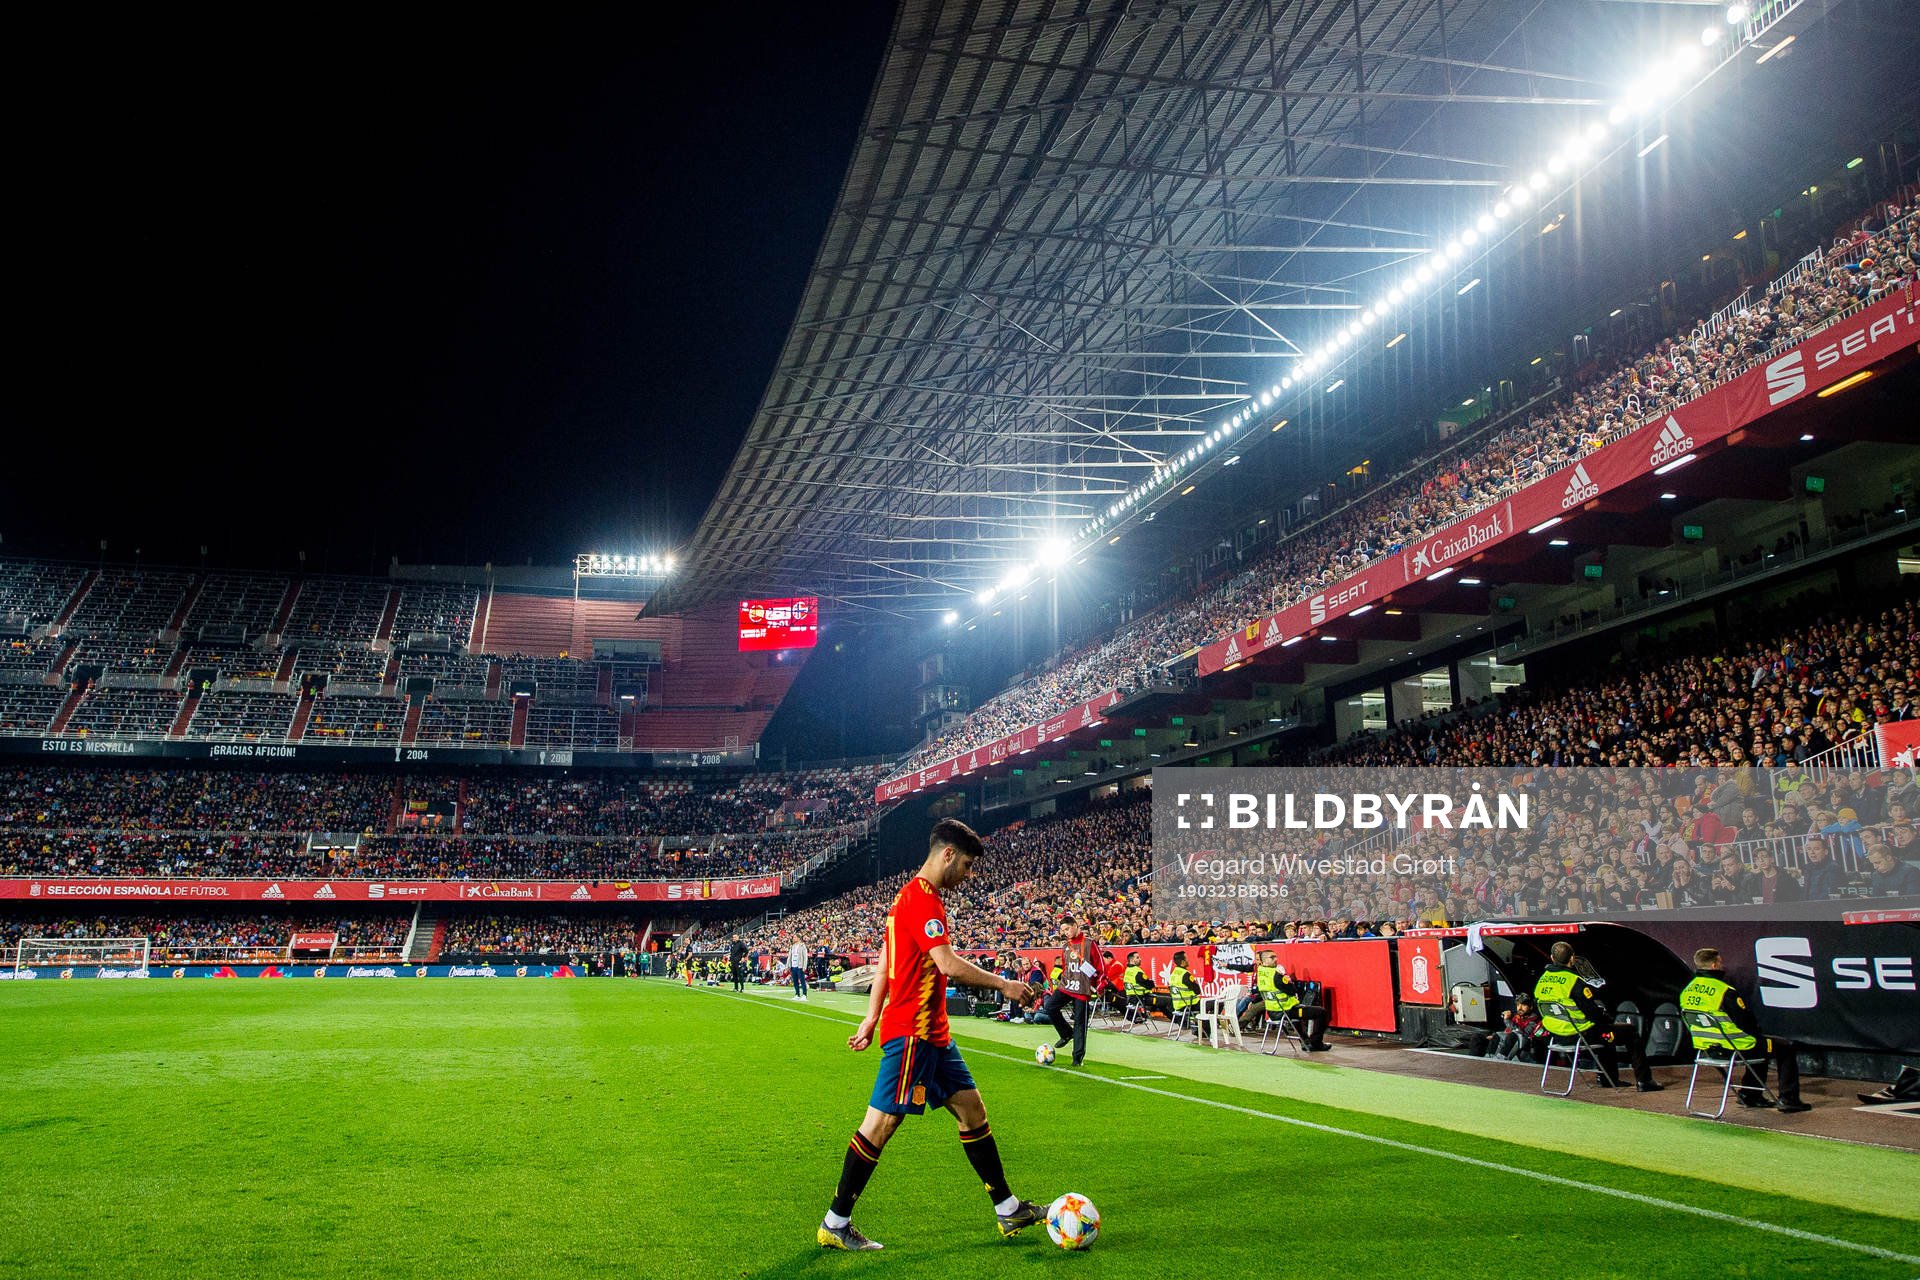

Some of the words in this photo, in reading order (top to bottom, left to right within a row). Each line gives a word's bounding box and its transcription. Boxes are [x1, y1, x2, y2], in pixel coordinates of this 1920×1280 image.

[1815, 299, 1920, 371] SEAT
[1650, 436, 1694, 466] adidas
[1561, 483, 1599, 509] adidas
[1431, 513, 1504, 564] CaixaBank
[1328, 580, 1368, 610] SEAT
[1046, 719, 1066, 734] SEAT
[42, 740, 69, 752] ESTO
[70, 741, 83, 752] ES
[85, 742, 135, 754] MESTALLA
[209, 745, 253, 757] ¡GRACIAS
[255, 744, 297, 757] AFICIÓN!
[406, 749, 429, 761] 2004
[47, 884, 112, 895] SELECCIÓN
[113, 884, 171, 896] ESPAÑOLA
[174, 886, 189, 896] DE
[190, 885, 230, 896] FÚTBOL
[388, 887, 428, 895] SEAT
[482, 886, 534, 897] CaixaBank
[685, 887, 717, 895] SET
